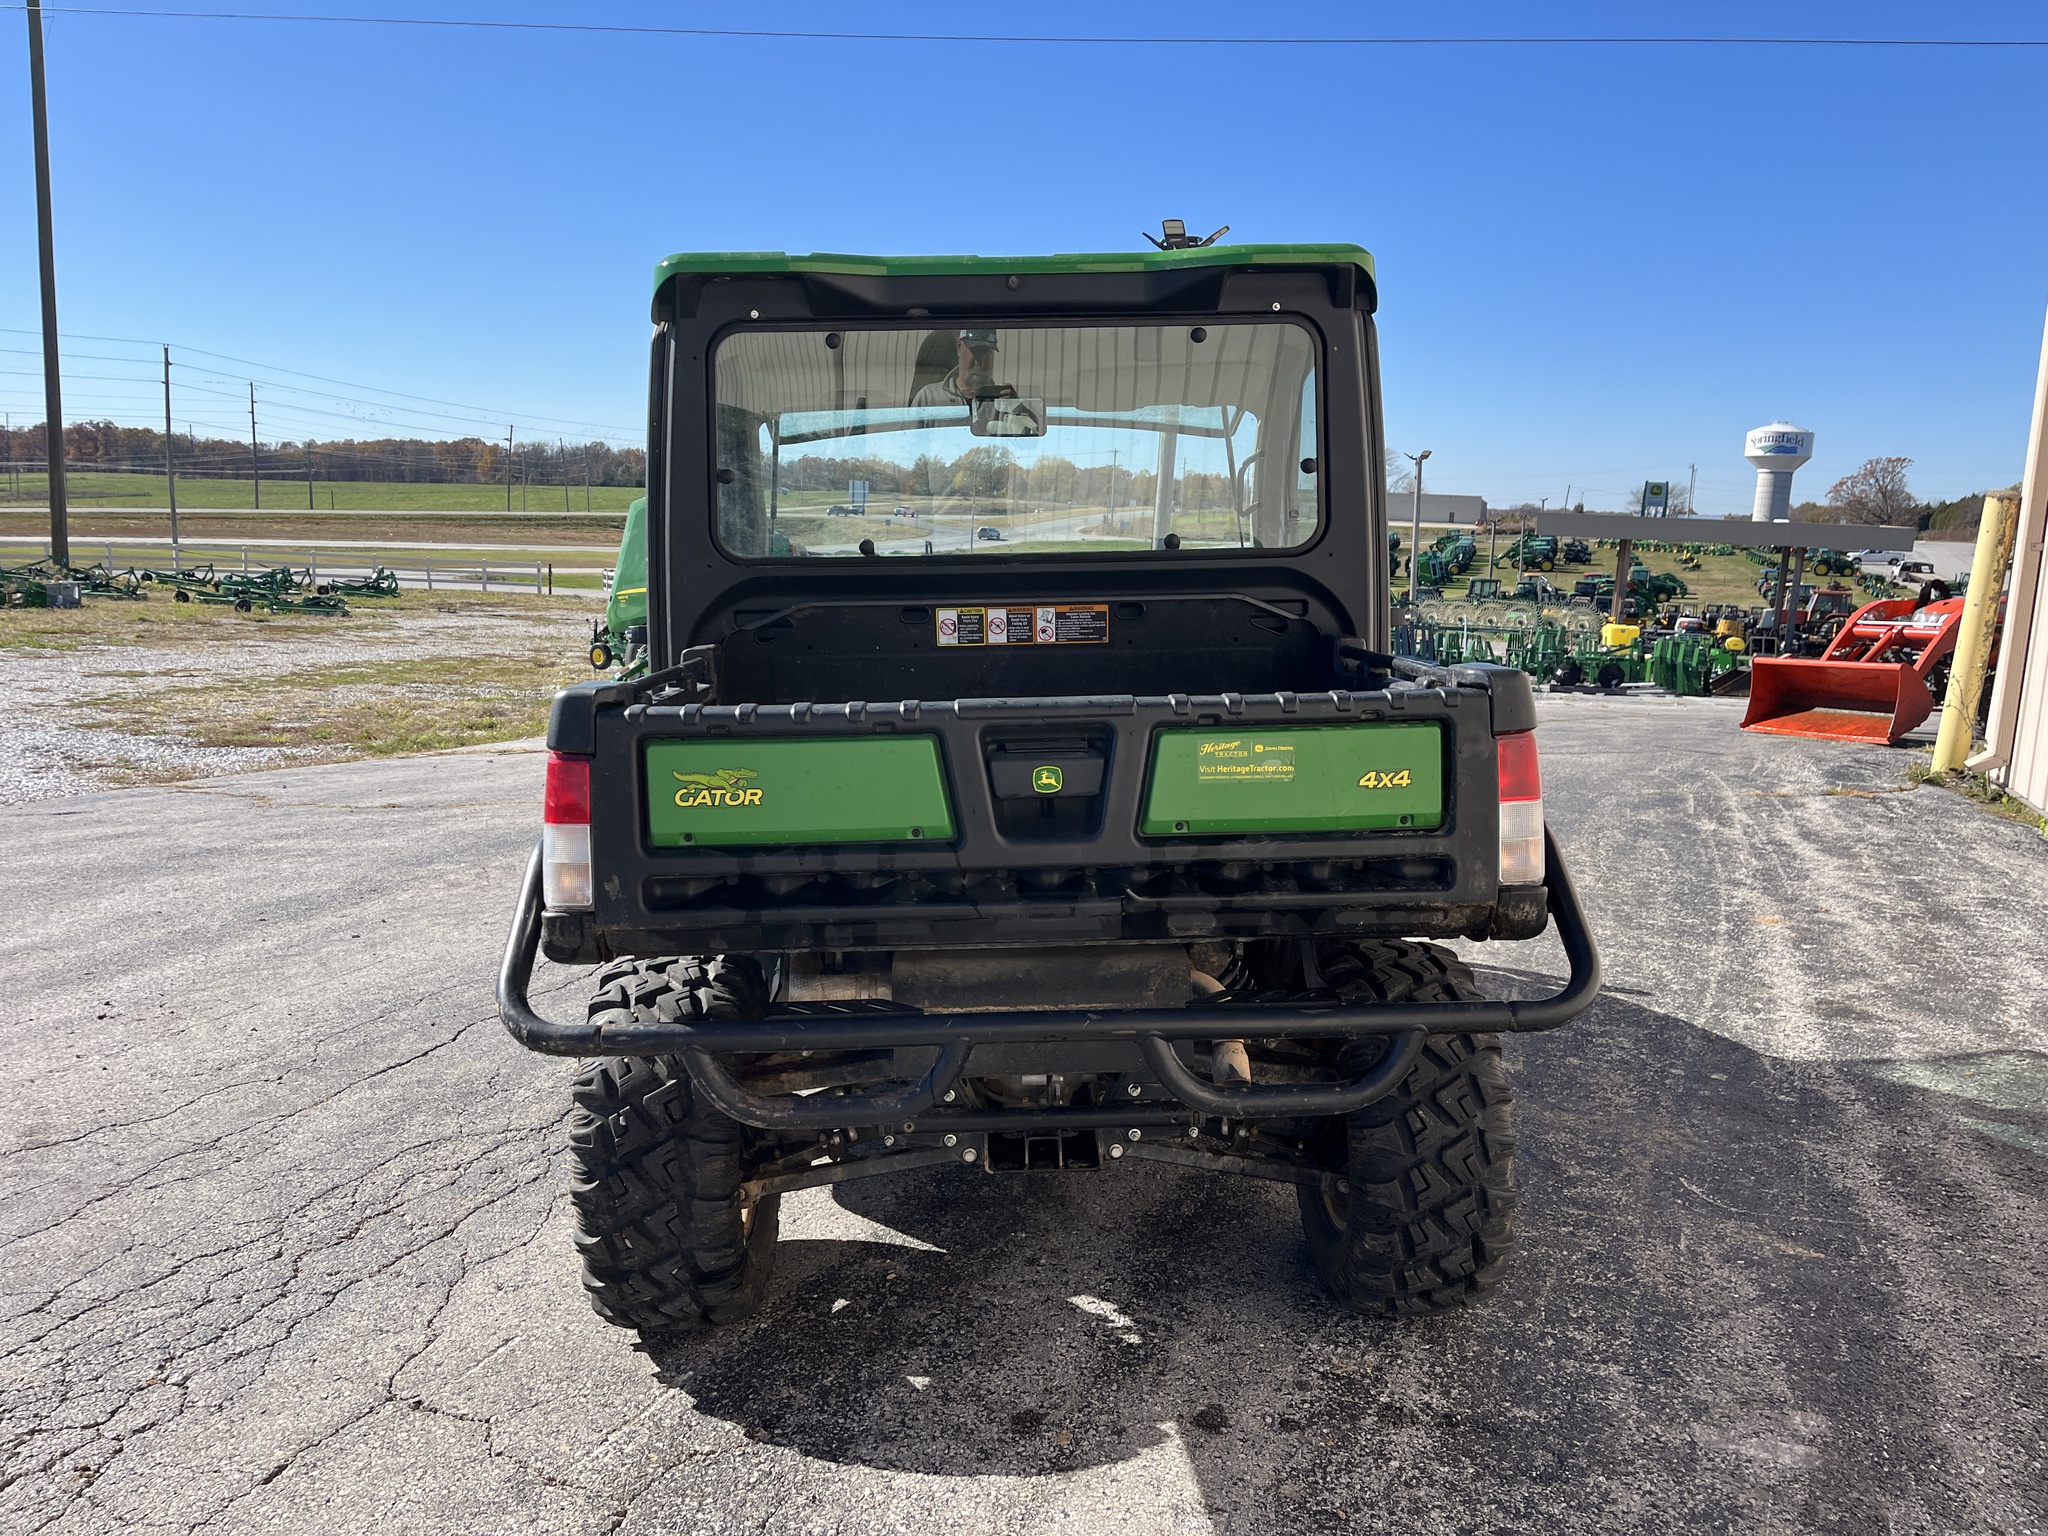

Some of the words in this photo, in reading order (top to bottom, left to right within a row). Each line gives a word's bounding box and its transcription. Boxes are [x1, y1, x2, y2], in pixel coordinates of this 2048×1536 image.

[1750, 432, 1805, 447] Springfield
[1199, 740, 1241, 756] Heritage
[1199, 765, 1216, 773] Visit
[1217, 765, 1295, 774] HeritageTractor.com
[674, 788, 763, 808] GATOR
